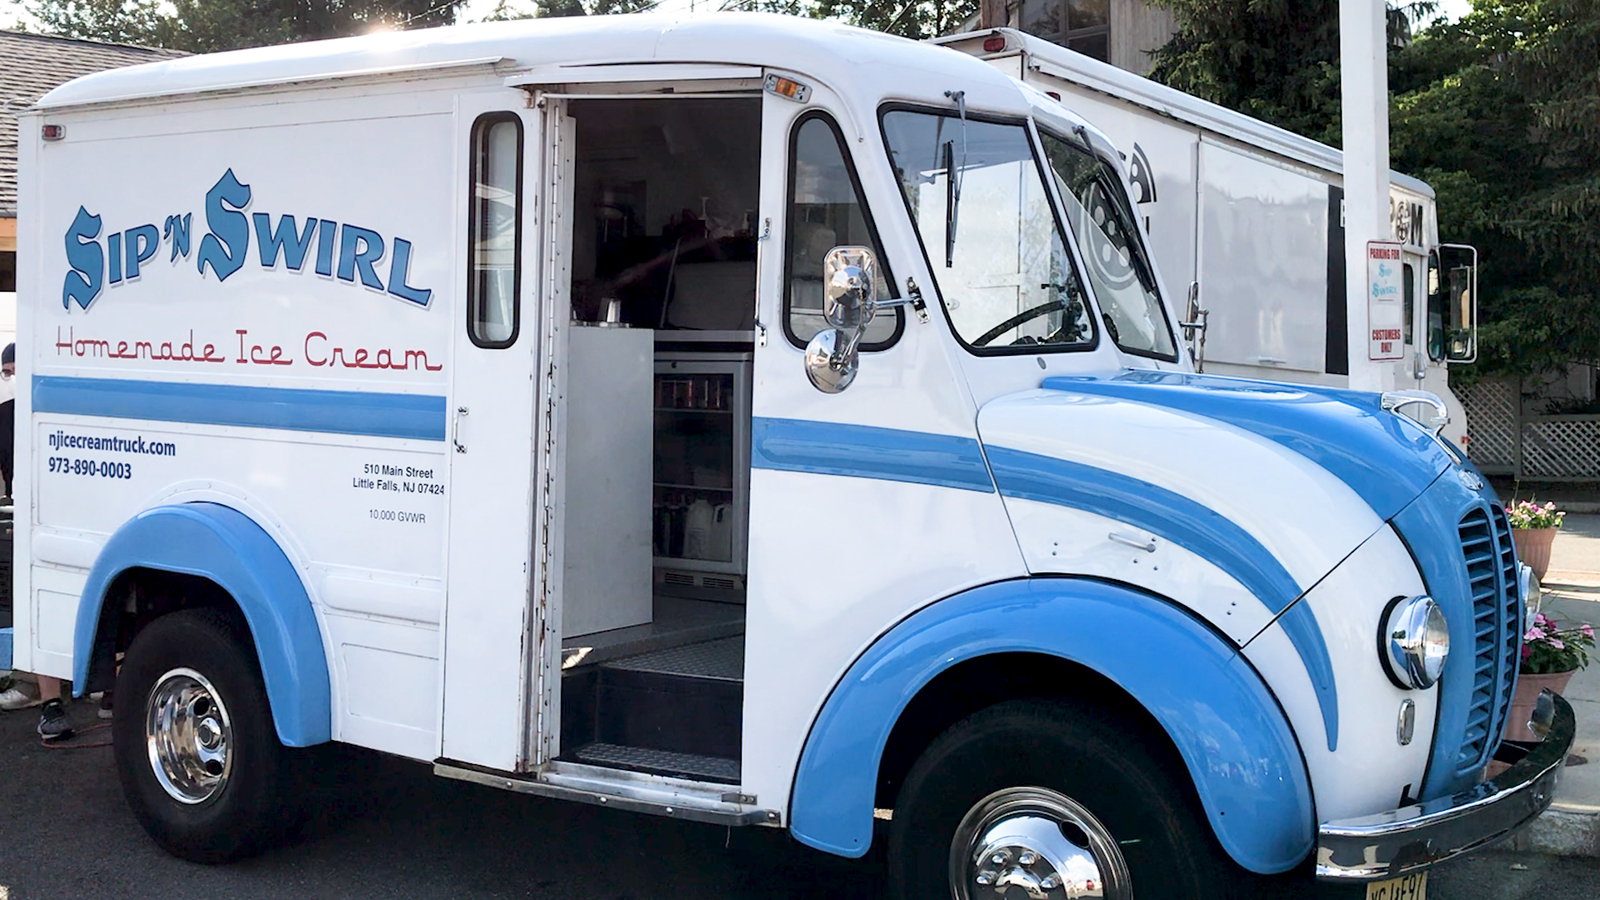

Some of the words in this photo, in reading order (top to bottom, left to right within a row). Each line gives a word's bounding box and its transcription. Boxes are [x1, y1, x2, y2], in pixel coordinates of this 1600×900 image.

[197, 168, 432, 307] SWIRL
[1370, 247, 1390, 259] PARKING
[1391, 249, 1400, 260] FOR
[1372, 329, 1401, 341] CUSTOMERS
[56, 326, 226, 363] Homemade
[236, 330, 293, 365] Ice
[305, 332, 443, 371] Cream
[1380, 342, 1392, 353] ONLY
[49, 430, 176, 457] njicecreamtruck.com
[49, 457, 132, 480] 973-890-0003
[364, 464, 380, 475] 510
[382, 465, 404, 477] Main
[406, 466, 434, 479] Street
[353, 477, 375, 490] Little
[377, 479, 401, 493] Falls,
[403, 481, 416, 493] NJ
[418, 483, 445, 496] 07424
[397, 511, 426, 523] GVWR
